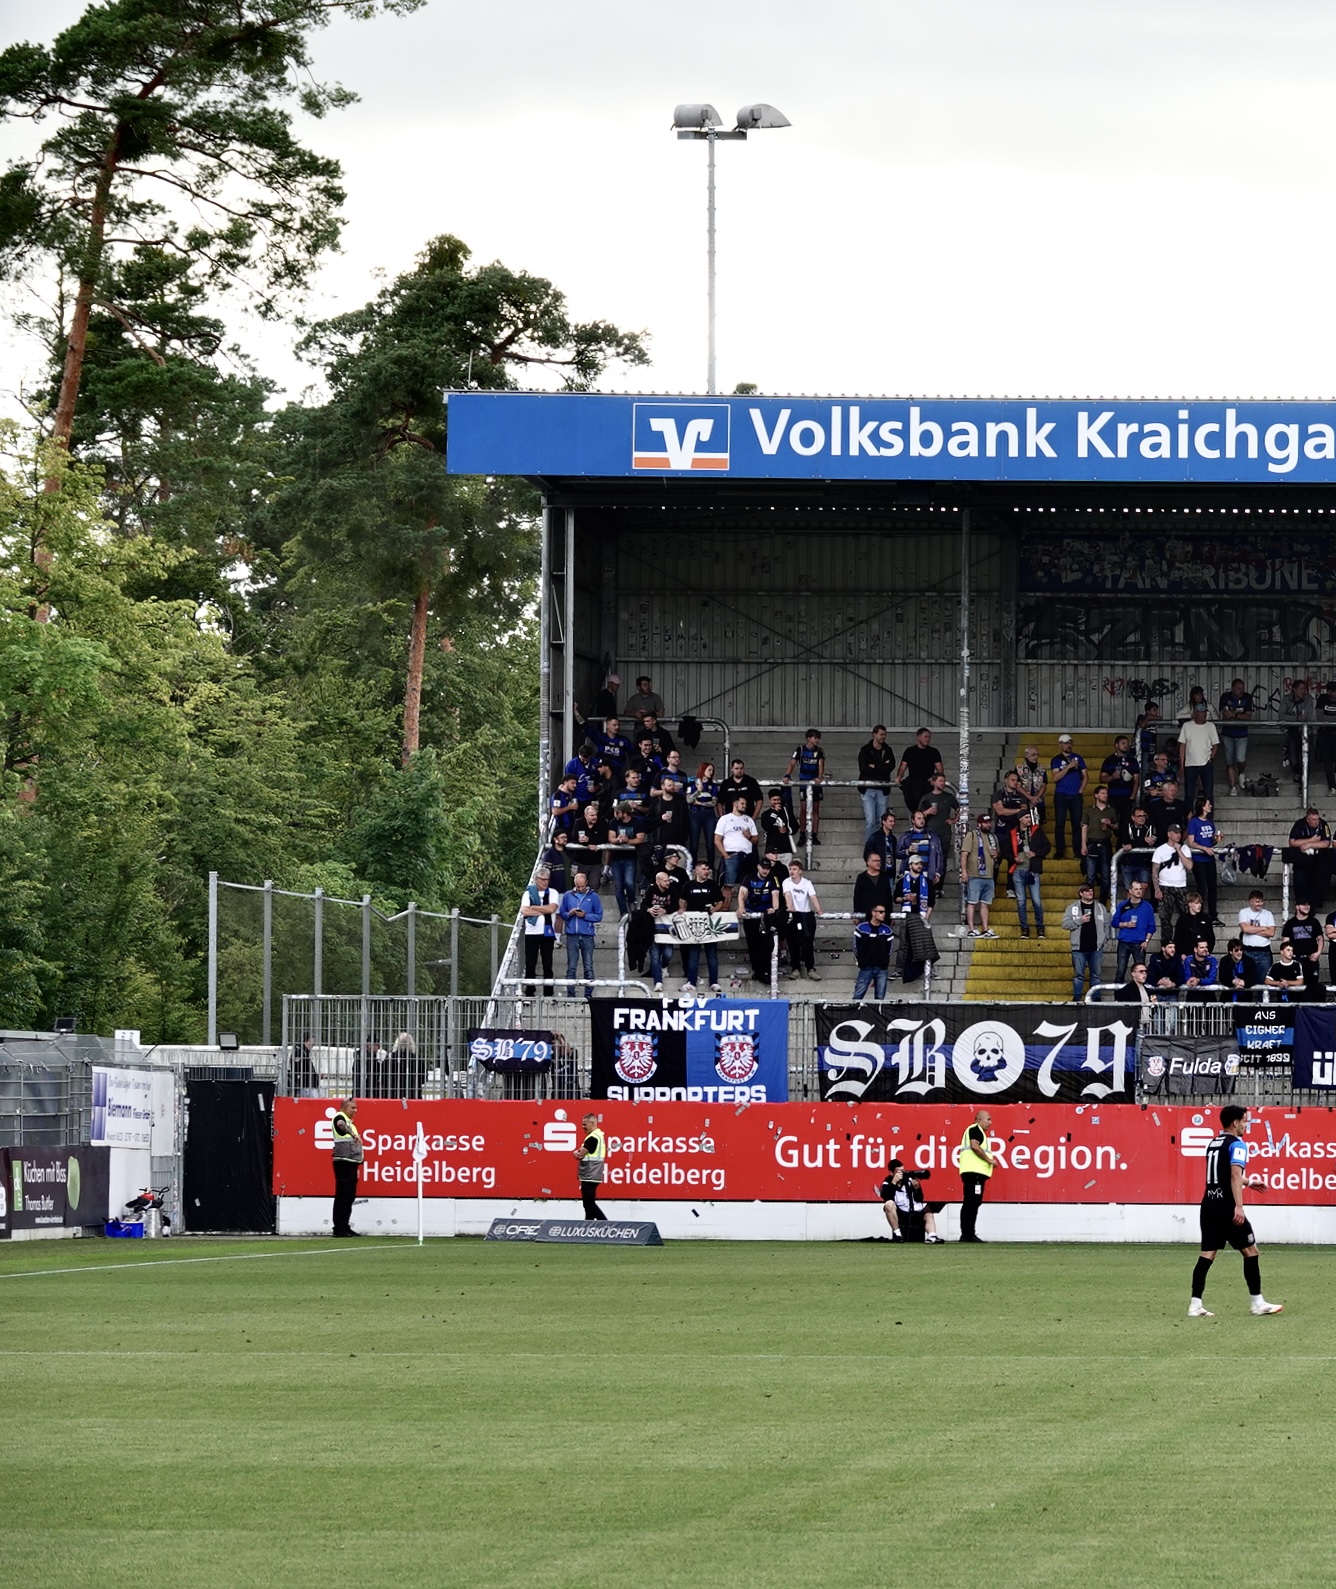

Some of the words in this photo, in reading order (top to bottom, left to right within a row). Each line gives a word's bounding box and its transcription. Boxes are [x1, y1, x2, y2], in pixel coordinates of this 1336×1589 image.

[749, 405, 1058, 458] Volksbank
[613, 1008, 760, 1031] FRANKFURT
[1169, 1056, 1222, 1075] Fulda
[1265, 1053, 1291, 1063] 1899
[606, 1130, 716, 1158] parkasse
[774, 1135, 841, 1170] Gut
[850, 1135, 904, 1170] für
[914, 1135, 960, 1170] die
[989, 1136, 1129, 1179] Region.
[1207, 1149, 1220, 1185] 11
[23, 1160, 45, 1183] Küchen
[46, 1161, 55, 1183] mit
[56, 1161, 67, 1183] Biss
[362, 1160, 496, 1189] Heidelberg
[25, 1195, 41, 1211] Thomas
